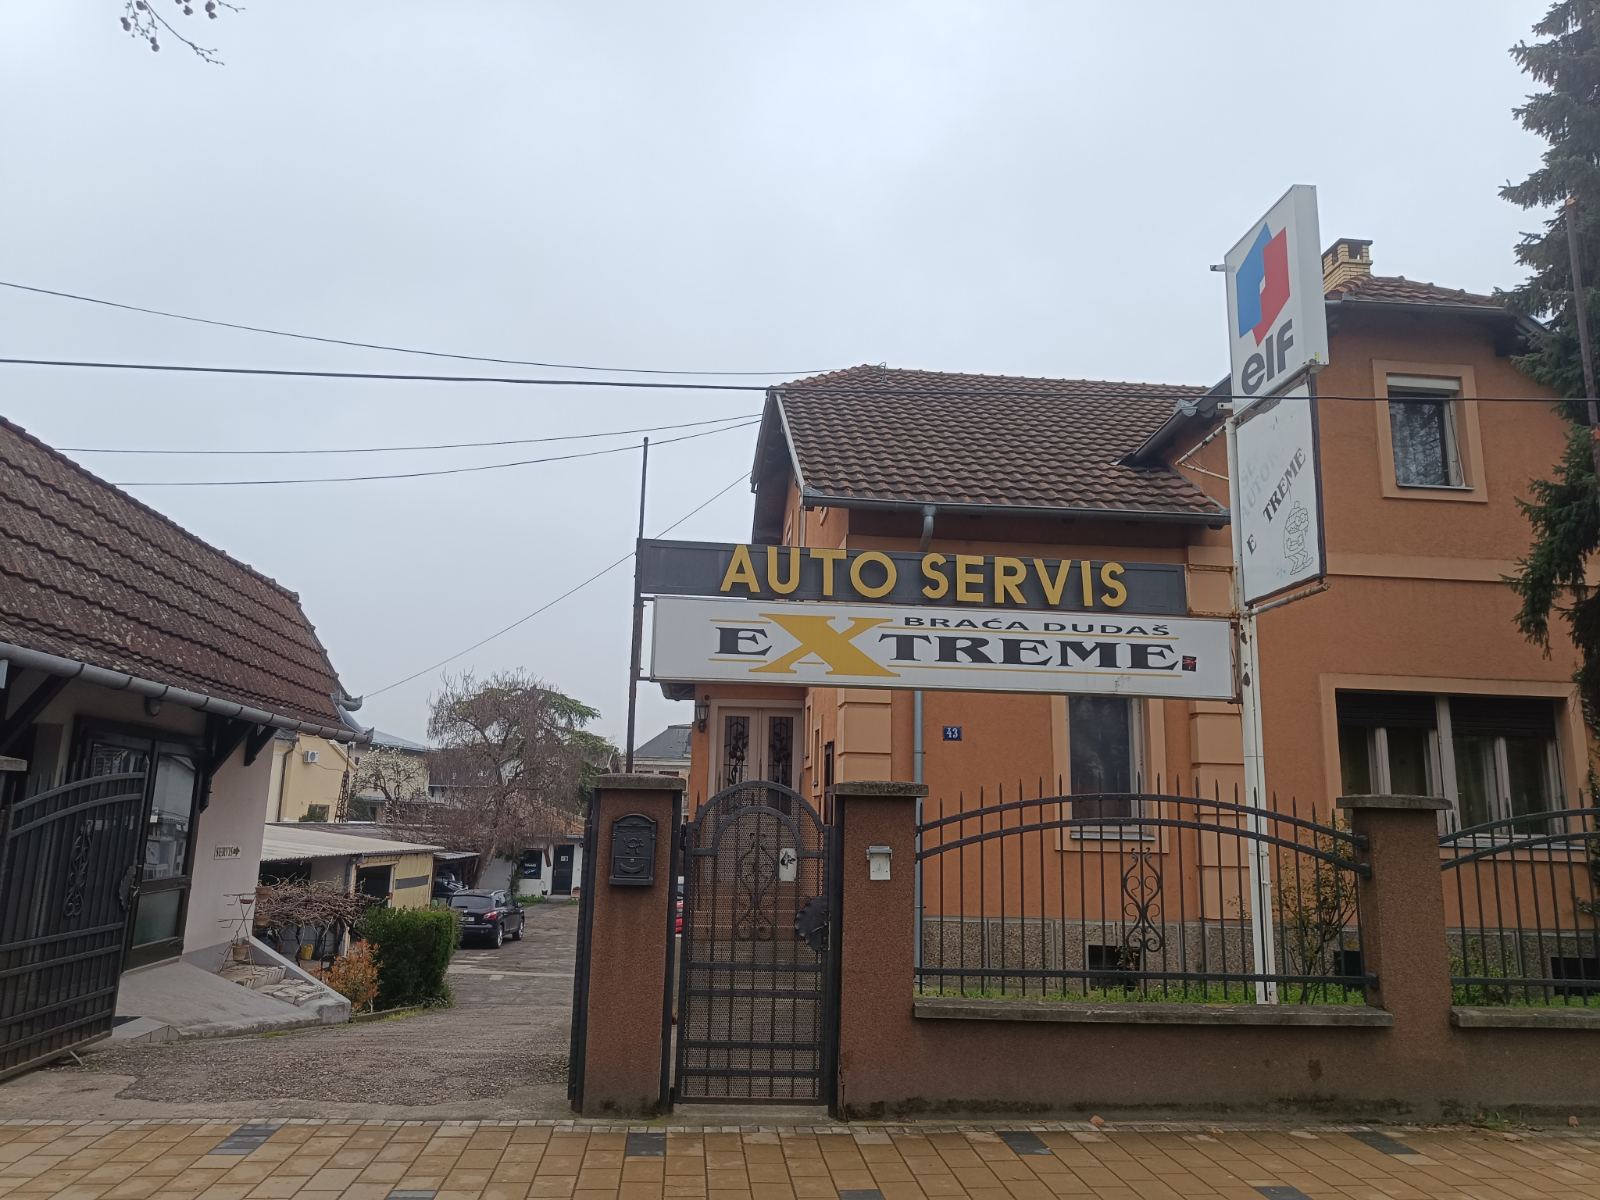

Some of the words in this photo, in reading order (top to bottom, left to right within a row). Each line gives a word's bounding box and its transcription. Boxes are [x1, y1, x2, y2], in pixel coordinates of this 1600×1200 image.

[1241, 318, 1294, 395] elf
[720, 545, 897, 598] AUTO
[921, 553, 1128, 607] SERVIS
[714, 613, 1180, 678] EXTREME
[903, 616, 1029, 631] BRAĆA
[1043, 622, 1171, 637] DUDAŠ
[946, 727, 958, 739] 43
